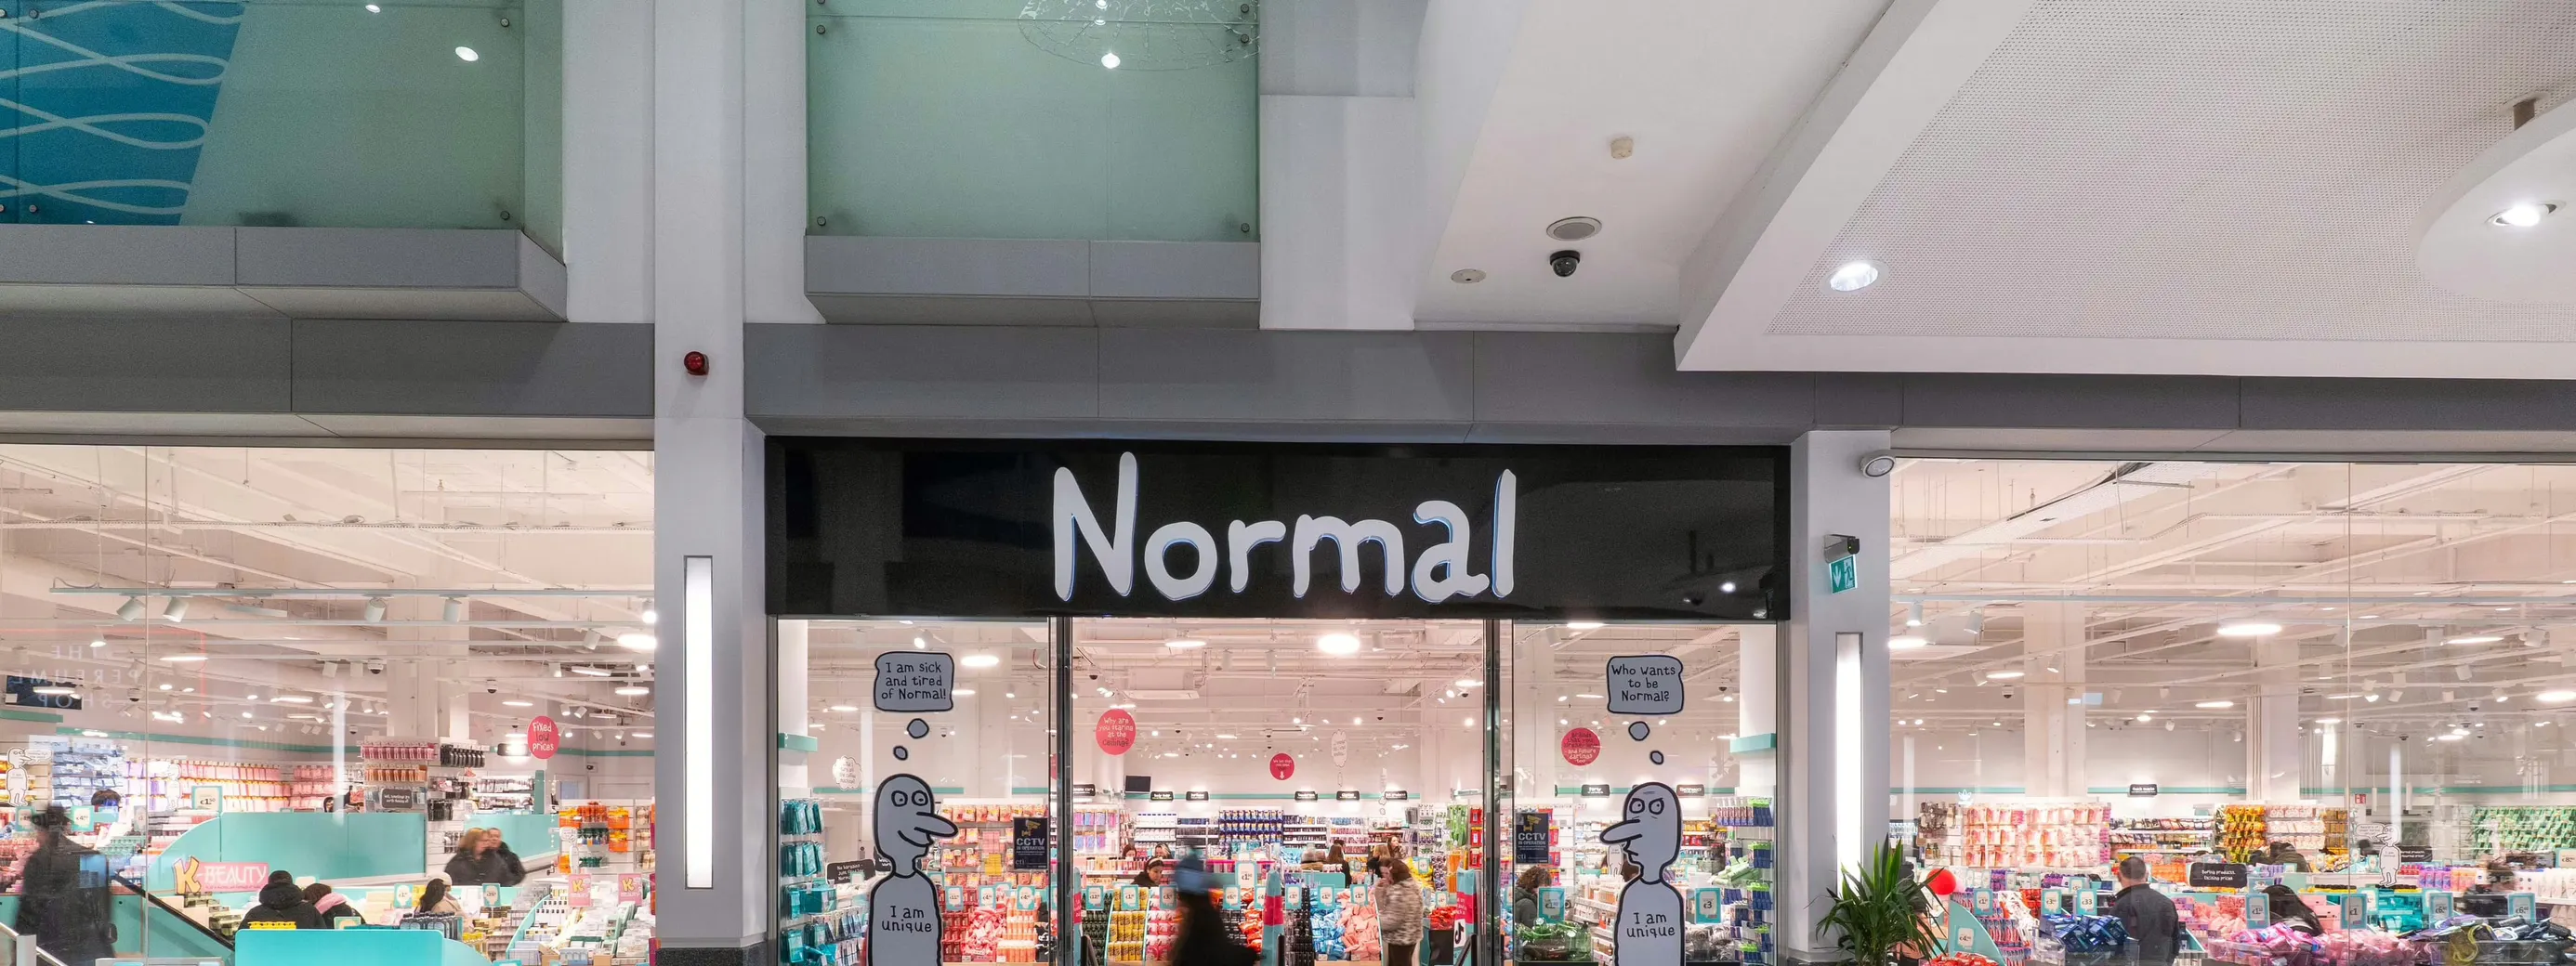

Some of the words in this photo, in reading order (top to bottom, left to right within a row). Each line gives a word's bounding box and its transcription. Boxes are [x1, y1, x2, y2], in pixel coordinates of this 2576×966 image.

[1054, 451, 1517, 603] Normal
[886, 661, 892, 673] I
[897, 663, 914, 673] am
[919, 661, 941, 673] sick
[1611, 663, 1636, 675] Who
[886, 675, 907, 686] and
[912, 675, 942, 686] tired
[1628, 678, 1641, 688] to
[1646, 676, 1659, 688] be
[881, 687, 894, 699] of
[899, 687, 946, 700] Normal!
[1622, 690, 1670, 701] Normal?
[532, 742, 554, 752] prices
[1016, 837, 1045, 846] CCTV
[1518, 832, 1546, 841] CCTV
[1703, 901, 1713, 909] €3
[890, 905, 896, 918] I
[903, 907, 925, 919] am
[1633, 912, 1640, 925] I
[1646, 913, 1667, 924] am
[881, 919, 932, 933] unique
[1626, 924, 1676, 938] unique
